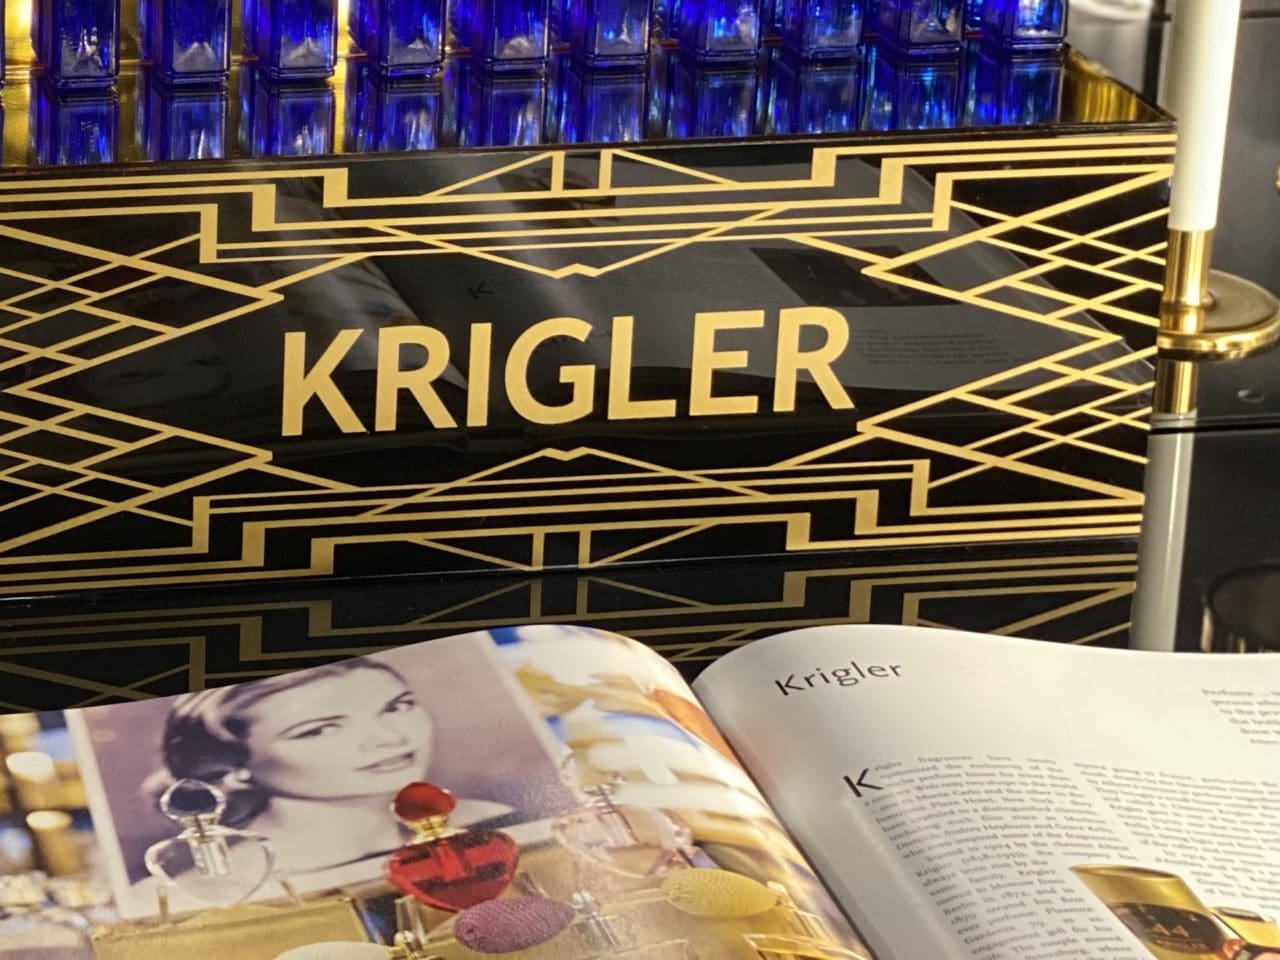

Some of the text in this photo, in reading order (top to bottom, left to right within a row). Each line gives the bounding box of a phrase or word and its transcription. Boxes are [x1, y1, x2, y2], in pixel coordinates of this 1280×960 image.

[282, 306, 855, 436] KRIGLER
[774, 660, 902, 696] Krigler
[843, 768, 883, 797] K
